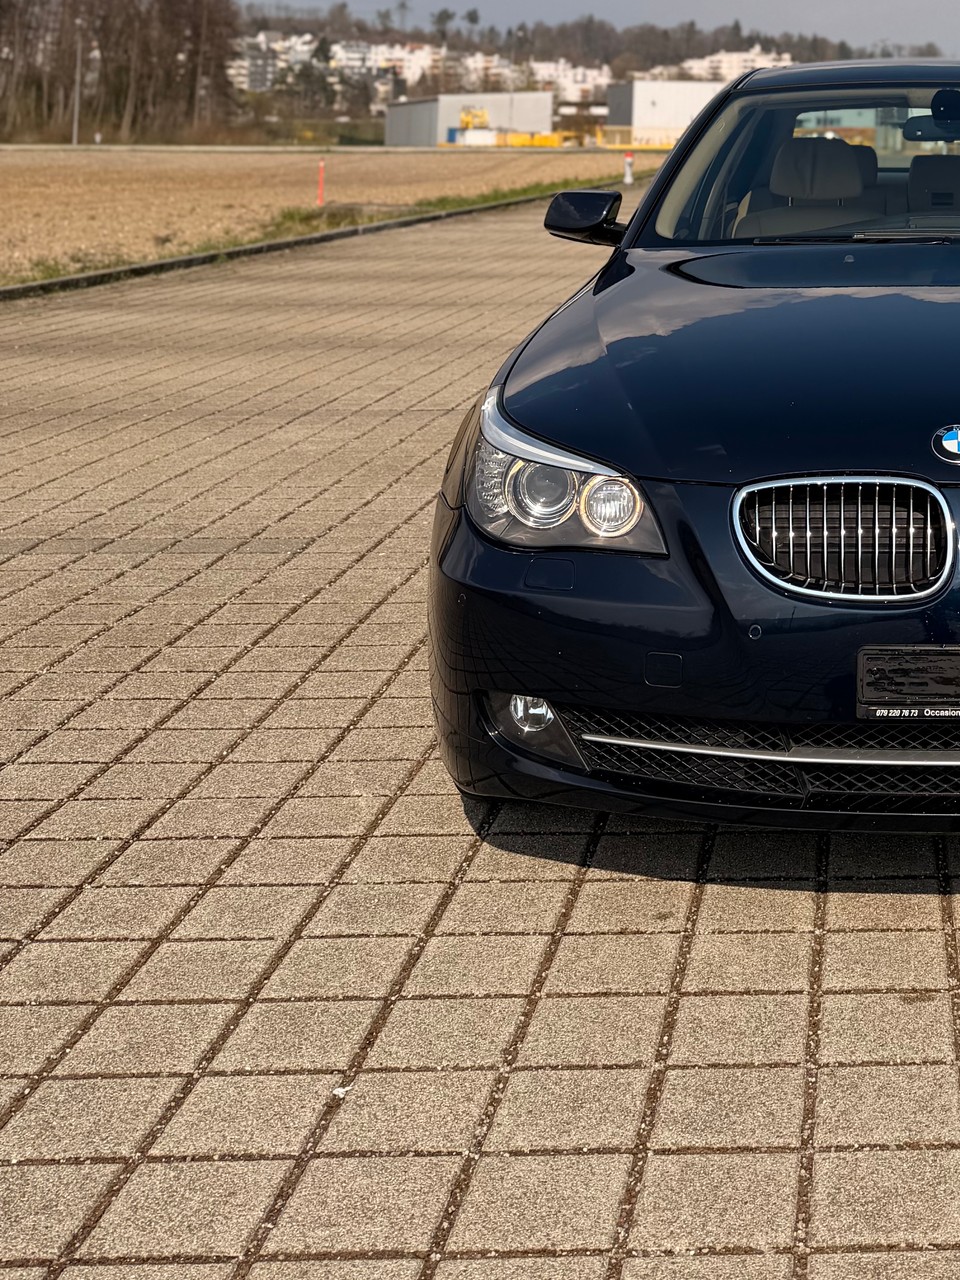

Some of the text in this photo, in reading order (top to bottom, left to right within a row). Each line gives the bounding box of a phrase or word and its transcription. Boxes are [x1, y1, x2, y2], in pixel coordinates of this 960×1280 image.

[876, 709, 888, 717] 079
[888, 709, 901, 717] 220
[910, 709, 919, 717] 73
[924, 708, 960, 716] Occasion
